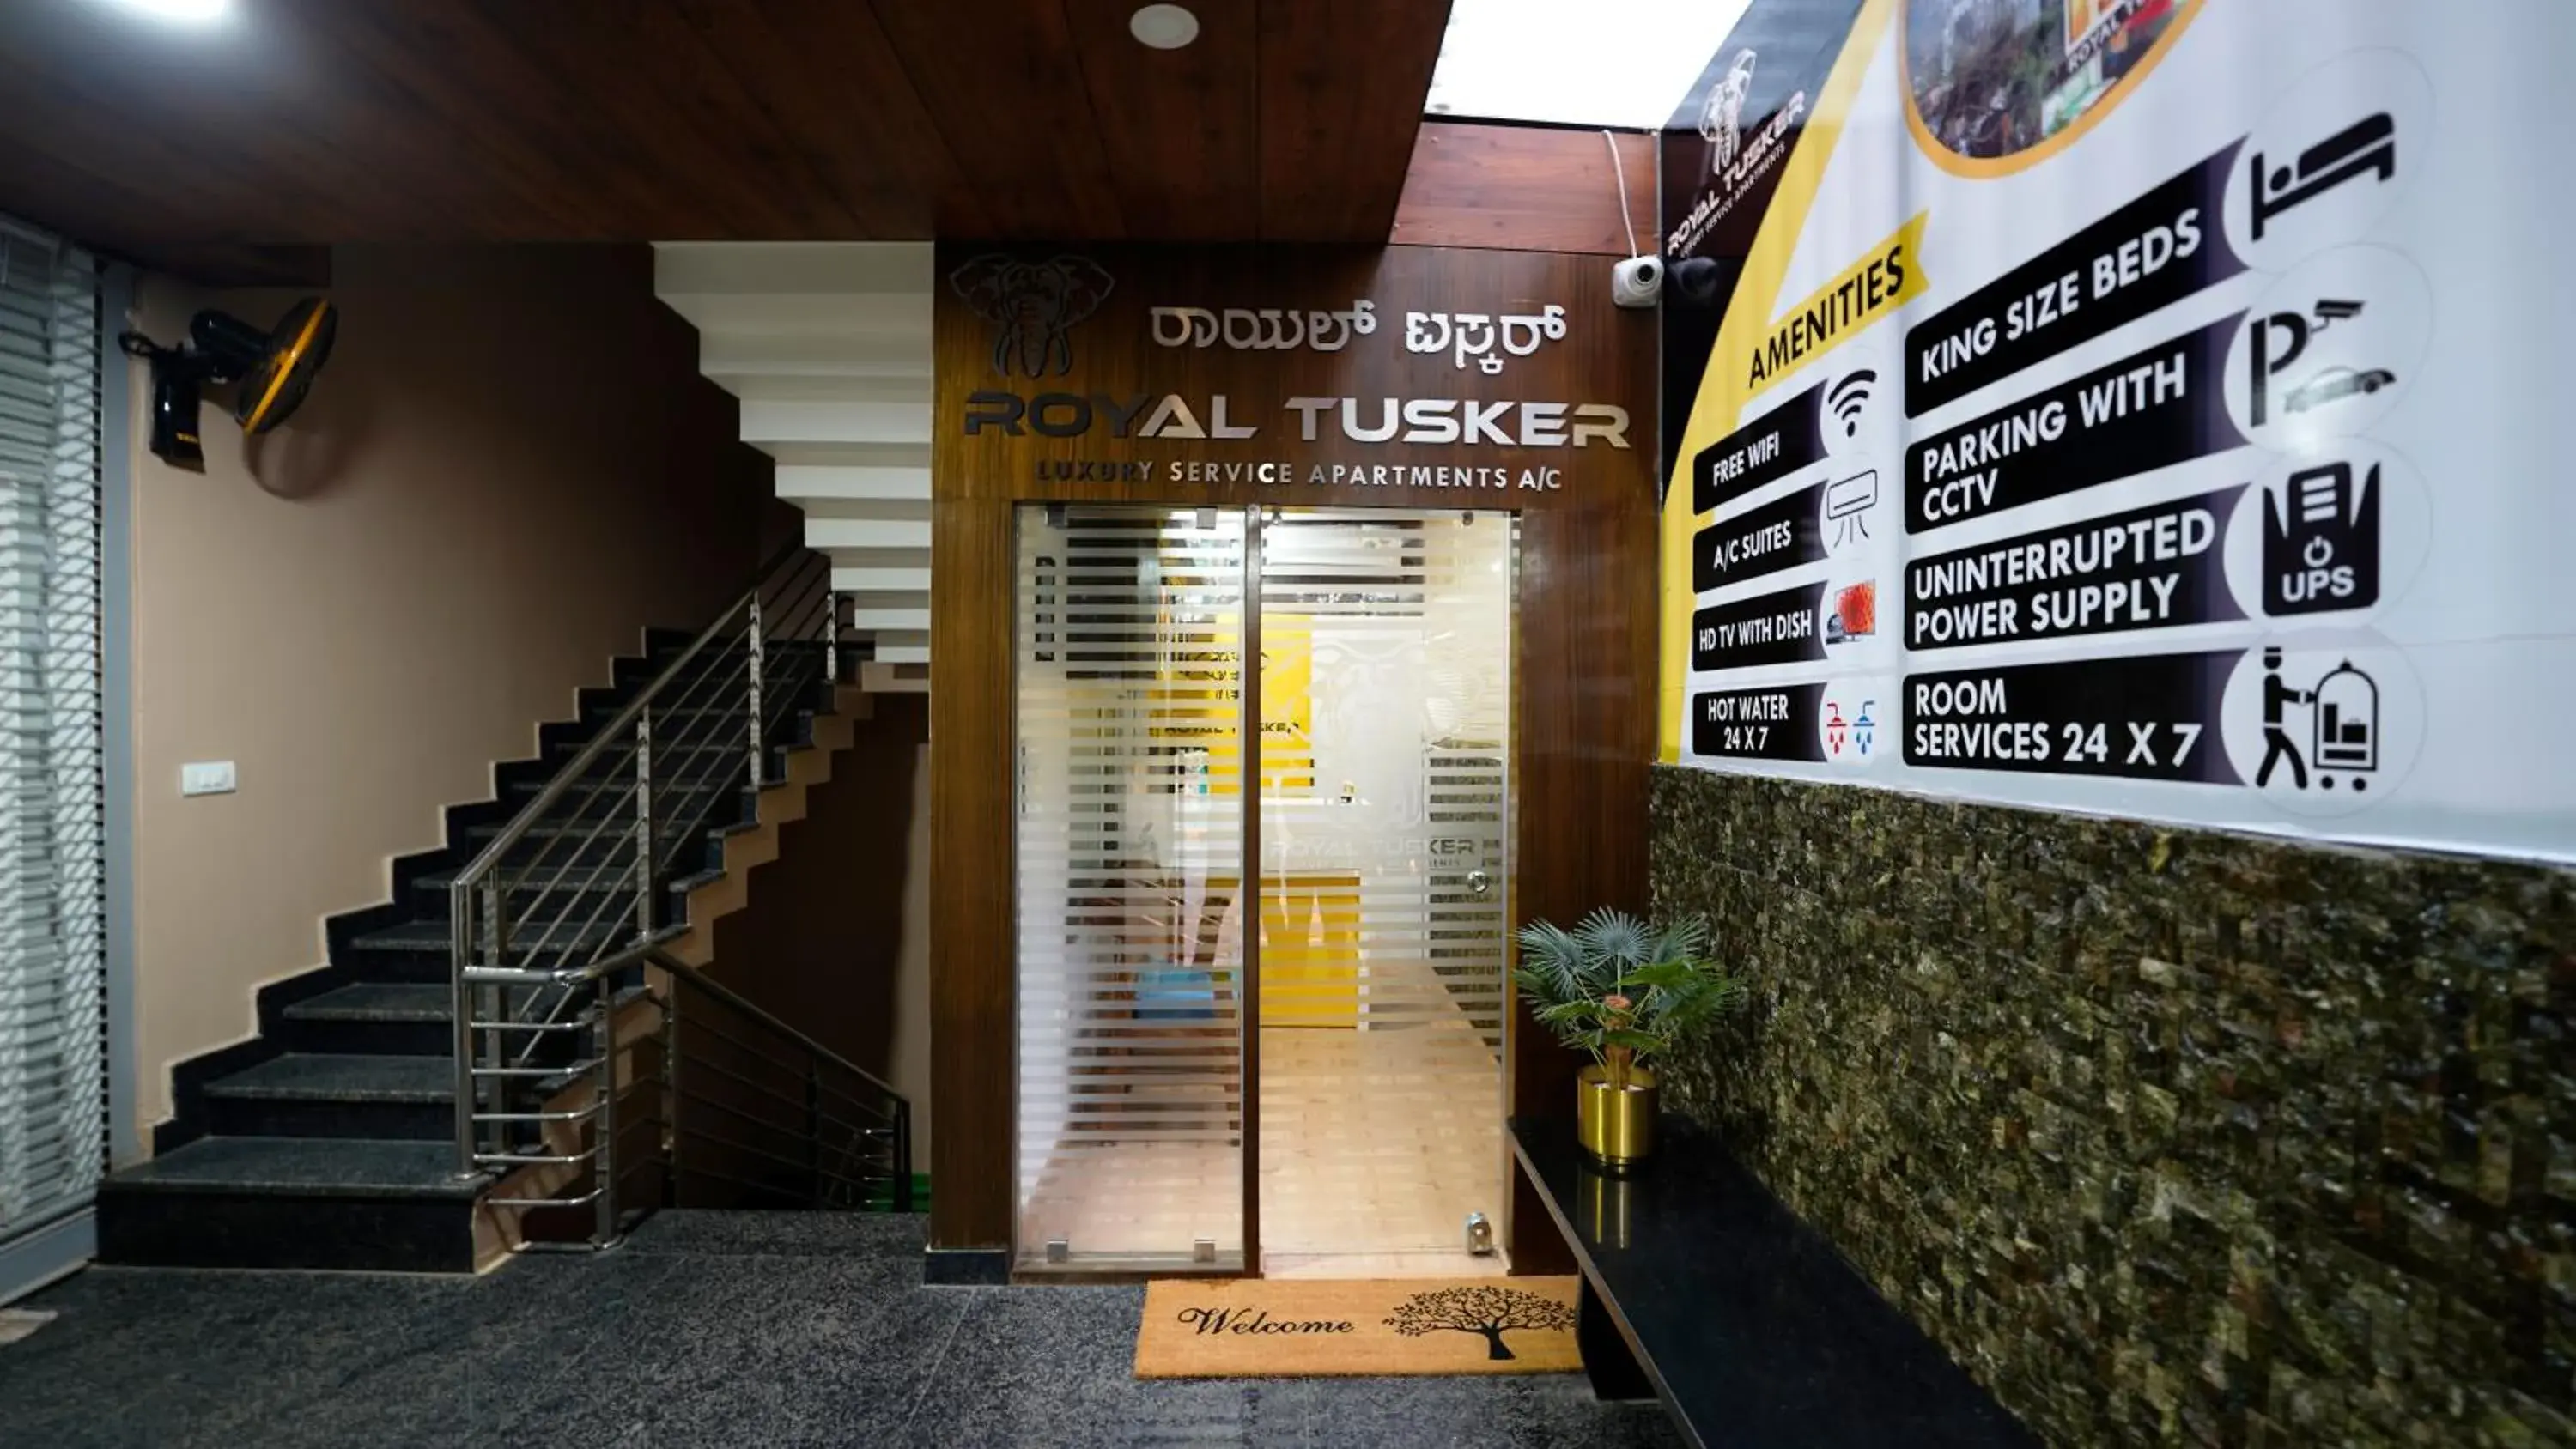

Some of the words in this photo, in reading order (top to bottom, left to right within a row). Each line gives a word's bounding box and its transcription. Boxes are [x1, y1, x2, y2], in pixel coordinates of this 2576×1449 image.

[1748, 245, 1905, 389] AMENITIES
[1922, 318, 1996, 383] KING
[2006, 270, 2079, 340] SIZE
[2092, 208, 2202, 300] BEDS
[1150, 299, 1376, 351] ರಾಯಲ್
[963, 393, 1257, 440] ROYAL
[1284, 397, 1631, 449] TUSKER
[1923, 400, 2067, 481] PARKING
[2078, 351, 2186, 428] WITH
[1037, 461, 1153, 483] LUXURY
[1170, 462, 1292, 485] SERVICE
[1309, 465, 1508, 488] APARTMENTS
[1518, 470, 1563, 492] A/C
[1713, 452, 1745, 486] FREE
[1748, 432, 1780, 469] WIFI
[1923, 468, 1999, 521] CCTV
[1713, 537, 1740, 572] A/C
[1741, 519, 1792, 560] SUITES
[1915, 509, 2215, 601] UNINTERRUPTED
[1915, 600, 2020, 644] POWER
[2030, 573, 2181, 632] SUPPLY
[2282, 566, 2355, 601] UPS
[1699, 629, 1716, 651] HD
[1718, 626, 1736, 647] TV
[1740, 619, 1773, 644] WITH
[1776, 608, 1812, 638] DISH
[1708, 699, 1737, 720] HOT
[1740, 694, 1789, 721] WATER
[1915, 678, 2007, 716] ROOM
[1724, 728, 1741, 747] 24
[1745, 727, 1756, 750] X
[1759, 726, 1769, 751] 7
[1915, 721, 2050, 761] SERVICES
[2063, 723, 2109, 763] 24
[2127, 724, 2157, 767] X
[2172, 724, 2202, 767] 7
[1177, 1307, 1355, 1337] Welcome
